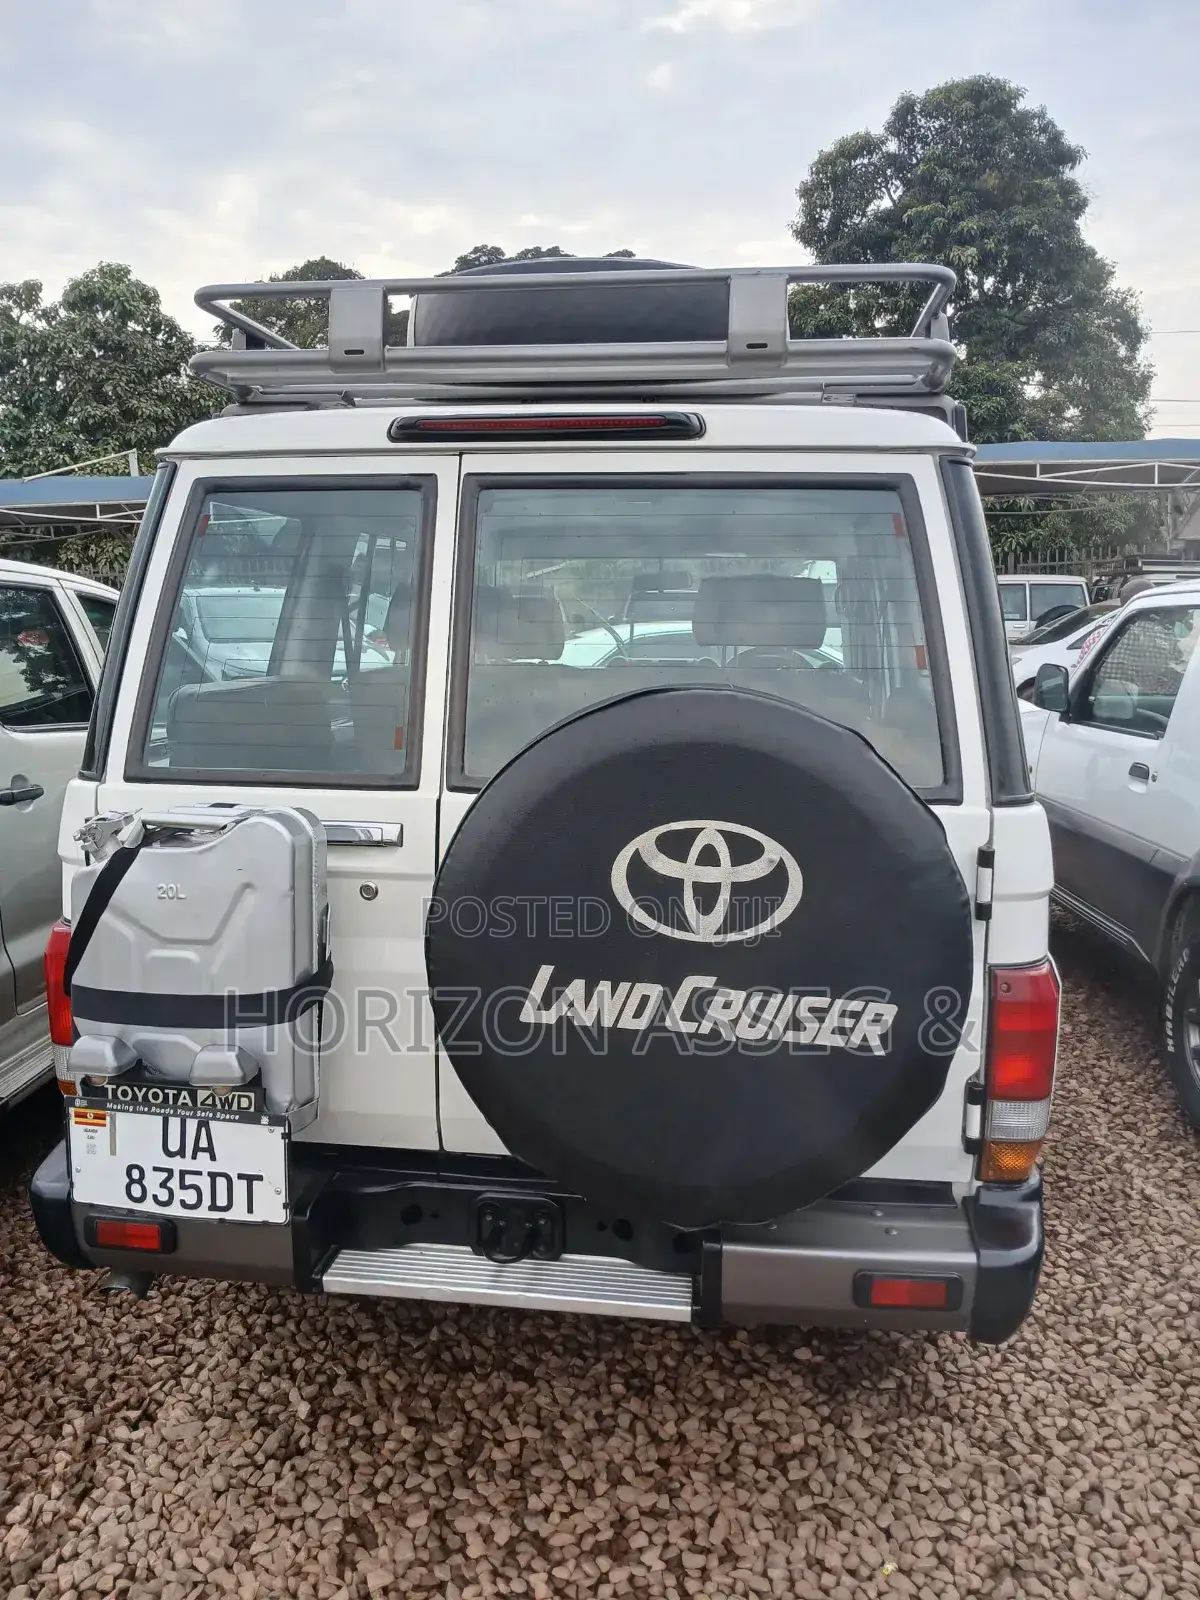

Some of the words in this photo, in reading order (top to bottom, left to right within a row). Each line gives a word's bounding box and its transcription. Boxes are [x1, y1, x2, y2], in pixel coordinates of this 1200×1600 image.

[156, 884, 187, 900] 20L
[104, 1085, 193, 1107] TOYOTA
[200, 1092, 253, 1111] 4WD
[106, 1102, 134, 1112] Making
[151, 1106, 174, 1115] Roads
[177, 1108, 194, 1117] Your
[196, 1110, 213, 1118] Safe
[216, 1112, 240, 1121] Space
[162, 1115, 217, 1162] UA
[125, 1163, 264, 1214] 835DT
